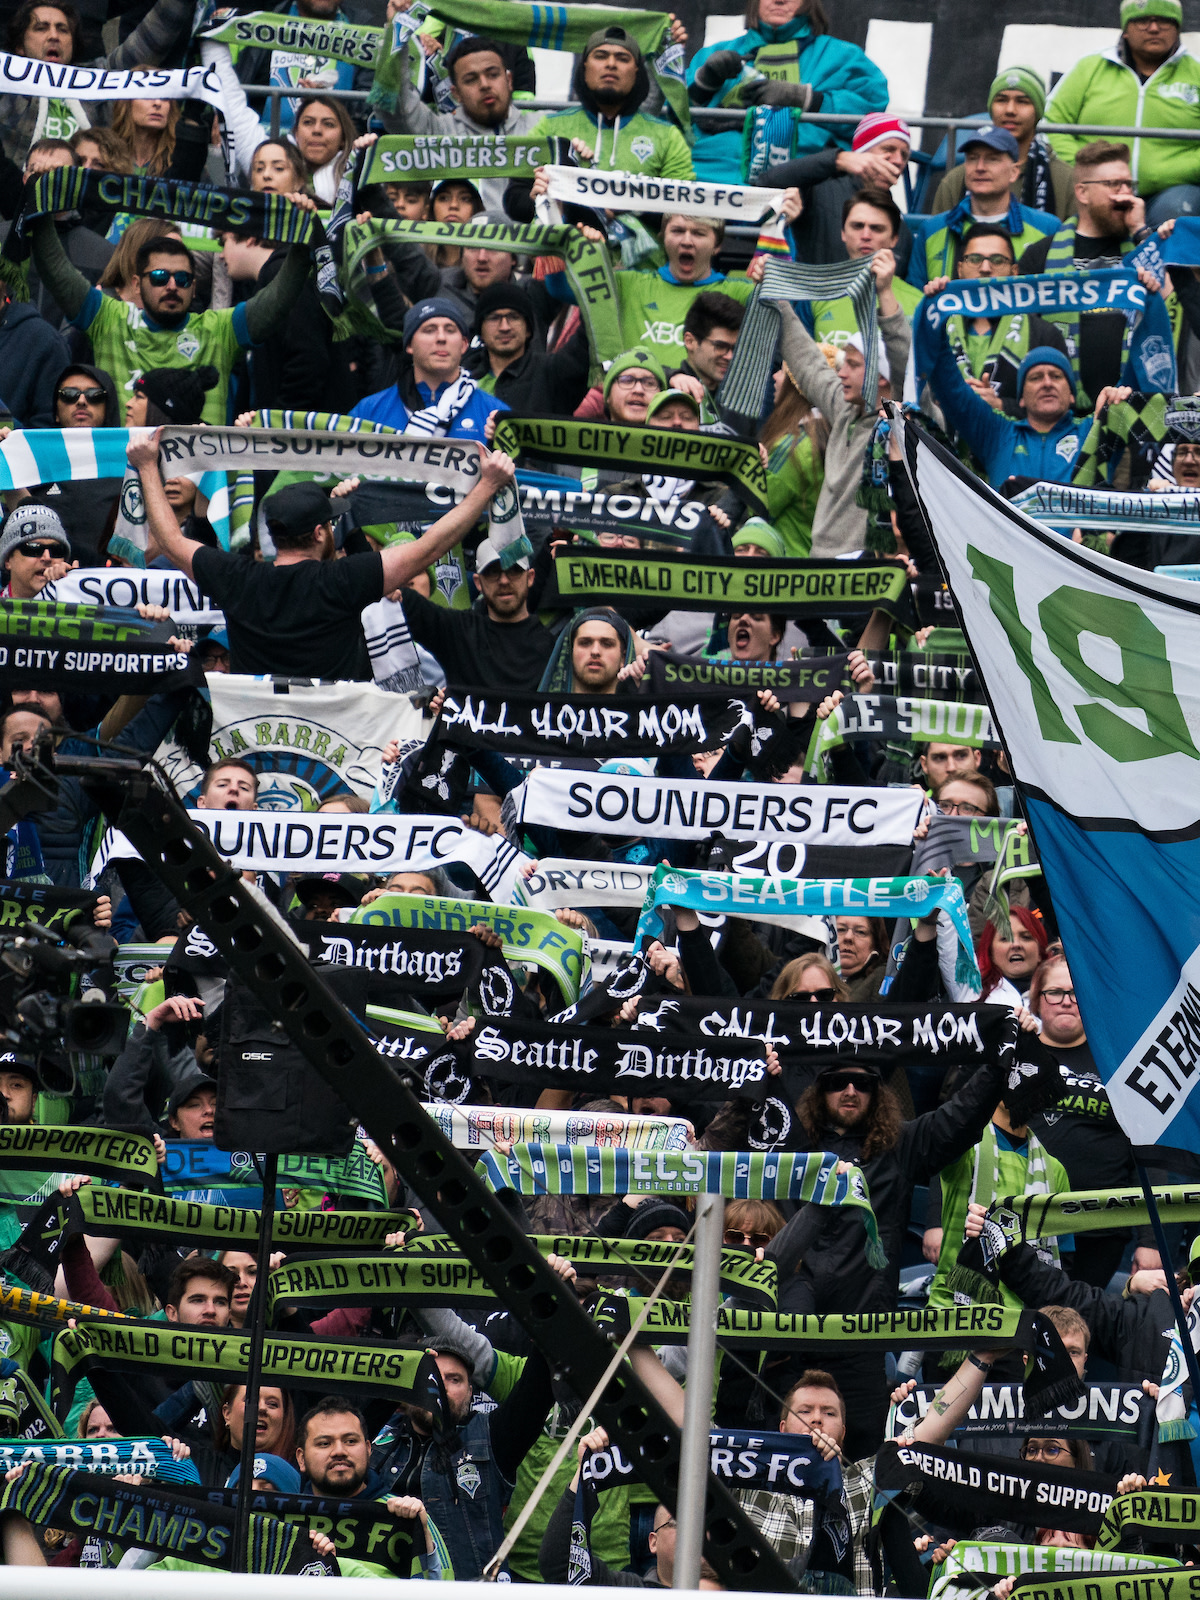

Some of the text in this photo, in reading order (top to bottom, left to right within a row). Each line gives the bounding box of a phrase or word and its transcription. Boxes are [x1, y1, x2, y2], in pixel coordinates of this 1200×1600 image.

[236, 21, 377, 63] SOUNDERS
[2, 56, 174, 90] UNDERS
[380, 146, 541, 172] SOUNDERS FC
[414, 135, 506, 148] SEATTLE
[98, 173, 253, 226] CHAMPS
[576, 177, 744, 207] SOUNDERS FC
[584, 269, 612, 304] FC
[925, 280, 1147, 329] SOUNDERS FC
[577, 429, 769, 495] CITY SUPPORTERS
[1035, 485, 1099, 515] SCORE
[1109, 491, 1170, 519] GOALS
[79, 577, 222, 611] SOUN
[568, 562, 895, 599] EMERALD CITY SUPPORTERS
[15, 650, 58, 670] CITY
[63, 650, 188, 675] SUPPORTERS
[966, 543, 1200, 763] 19
[664, 664, 830, 688] SOUNDERS FC
[912, 664, 974, 689] CITY
[530, 702, 629, 747] YOUR
[637, 704, 707, 747] MOM
[211, 721, 350, 769] LA BARRA
[567, 782, 878, 833] SOUNDERS FC
[405, 824, 464, 861] FC
[731, 840, 806, 879] 20
[701, 874, 892, 908] SEATTLE
[424, 899, 519, 919] SEATTLE
[318, 934, 463, 984] Dirtbags
[539, 929, 581, 977] FC
[699, 1007, 985, 1054] CALL YOUR MOM
[241, 1052, 274, 1062] QSC
[473, 1025, 768, 1090] Seattle Dirtbags
[0, 1127, 153, 1166] SUPPORTERS
[468, 1110, 551, 1145] FOR
[567, 1115, 691, 1151] PRIDE
[632, 1150, 705, 1182] ECS
[637, 1182, 700, 1192] EST. 2005
[91, 1190, 202, 1229] EMERALD
[213, 1204, 263, 1233] CITY
[551, 1238, 616, 1260] CITY
[359, 1263, 409, 1289] CITY
[646, 1301, 1004, 1334] EMEALD CITY SUPPORTERS
[171, 1336, 228, 1363] CITY
[768, 1452, 812, 1487] FC
[896, 1448, 981, 1488] EMERALD
[987, 1472, 1032, 1502] CITY
[115, 1489, 141, 1503] 2019
[69, 1493, 232, 1560] CHAMPS
[366, 1524, 414, 1564] FC
[1115, 1576, 1174, 1600] CITY
